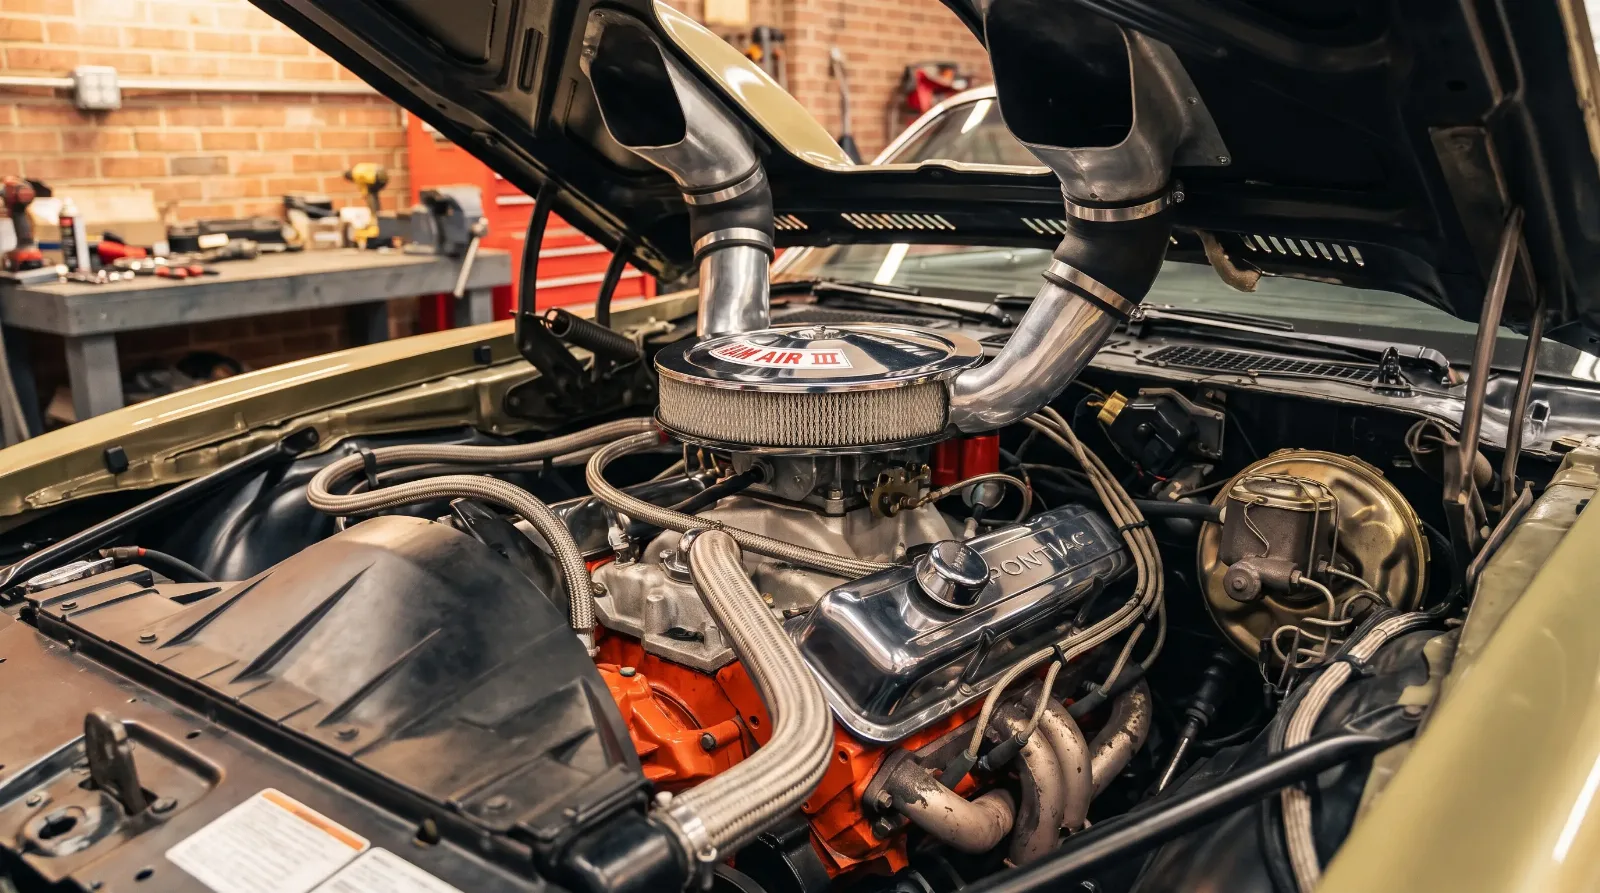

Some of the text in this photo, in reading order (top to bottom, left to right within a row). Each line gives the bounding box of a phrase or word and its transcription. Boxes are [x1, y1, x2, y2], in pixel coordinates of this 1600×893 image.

[754, 351, 803, 365] AIR
[811, 352, 840, 365] III
[988, 531, 1094, 585] PONTIAC
